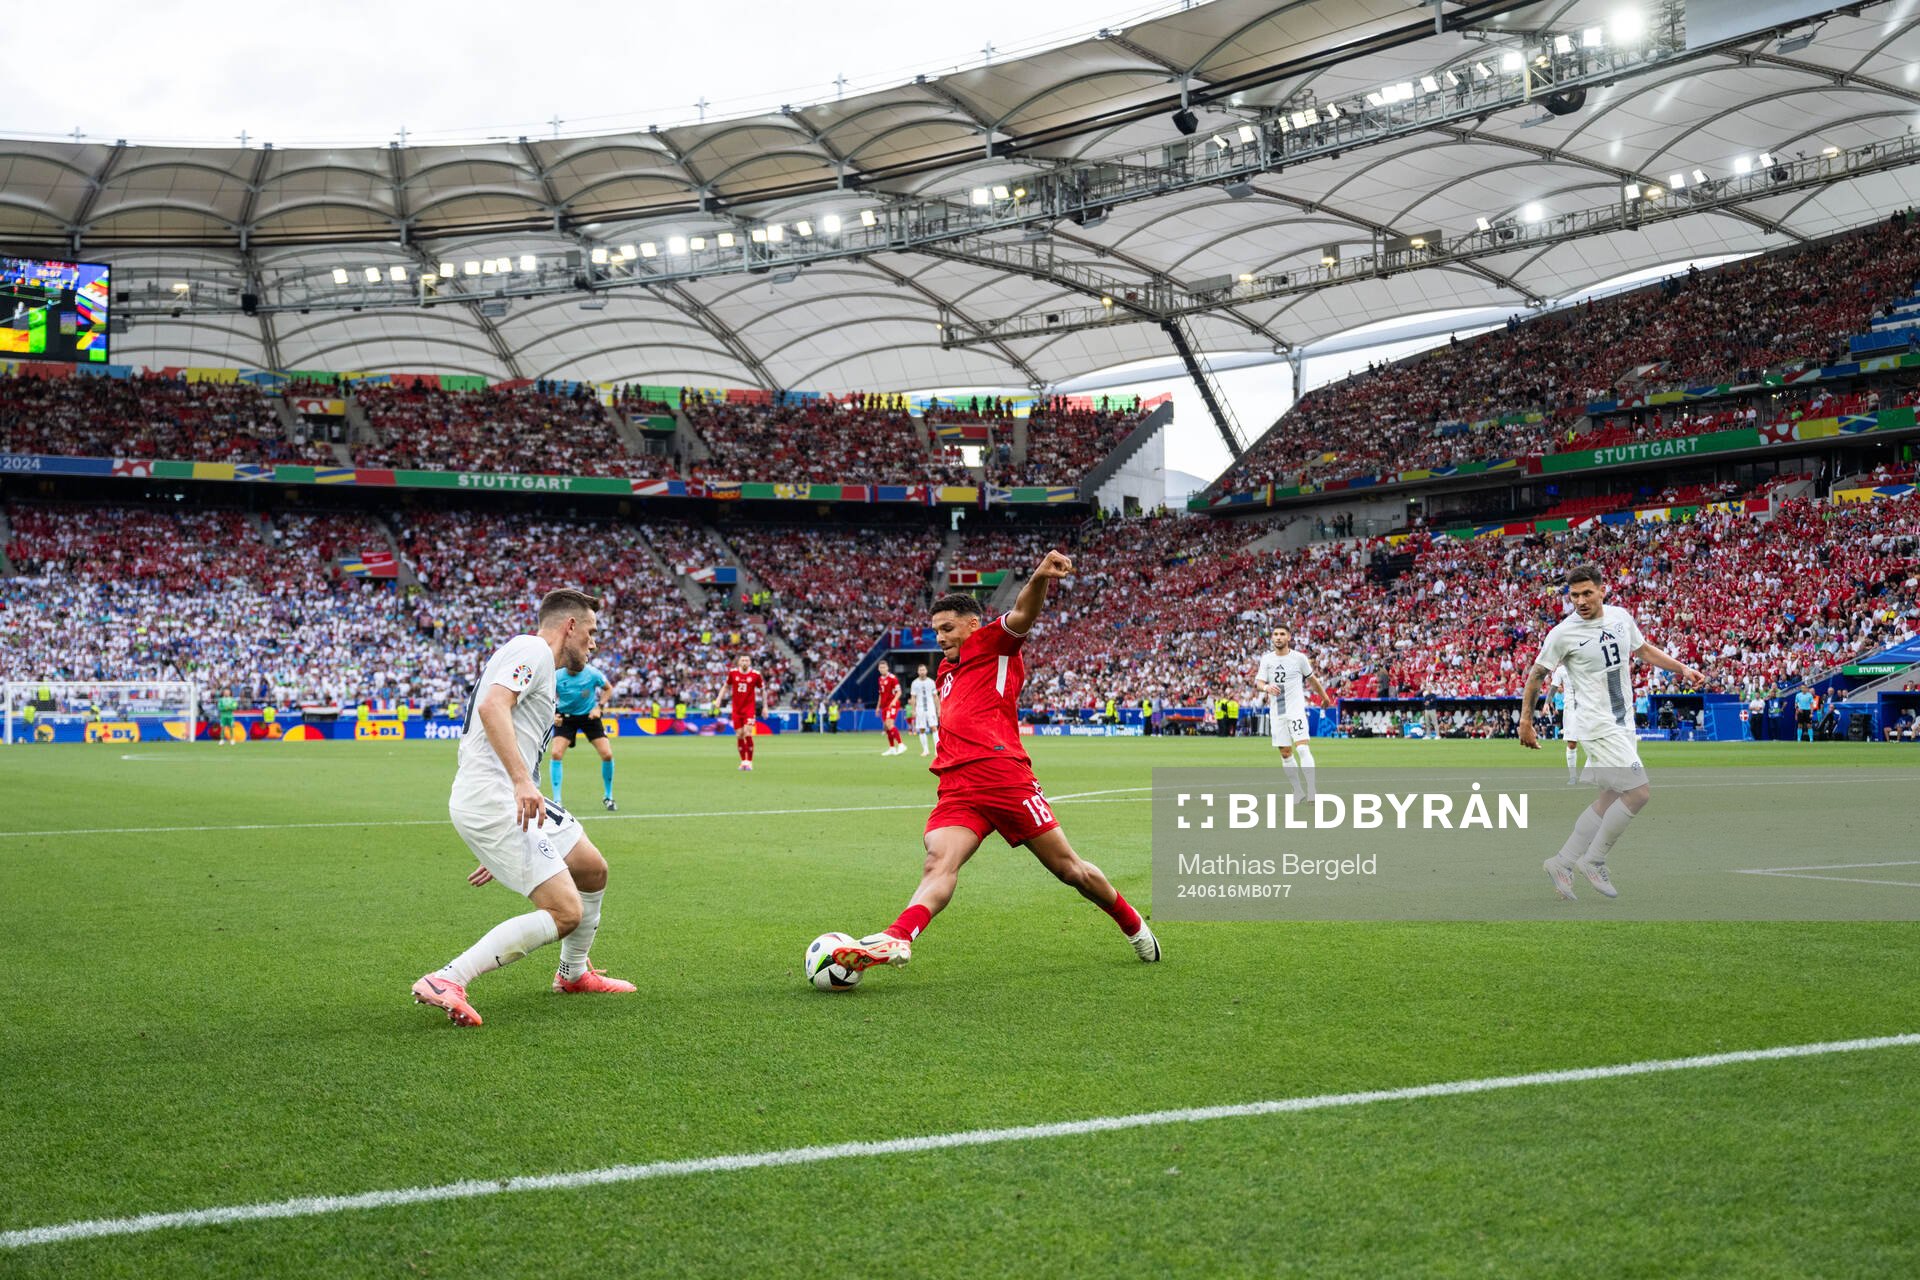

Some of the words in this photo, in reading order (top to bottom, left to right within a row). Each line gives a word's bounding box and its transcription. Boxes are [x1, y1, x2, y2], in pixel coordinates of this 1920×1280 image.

[1594, 437, 1698, 464] STUTTGART
[3, 457, 41, 470] 2024
[458, 474, 573, 490] STUTTGART
[1601, 643, 1621, 667] 13
[1274, 671, 1286, 683] 22
[1858, 666, 1895, 674] STUTTGART
[359, 722, 401, 737] LIDL
[1292, 719, 1304, 732] 22
[1022, 794, 1053, 827] 18
